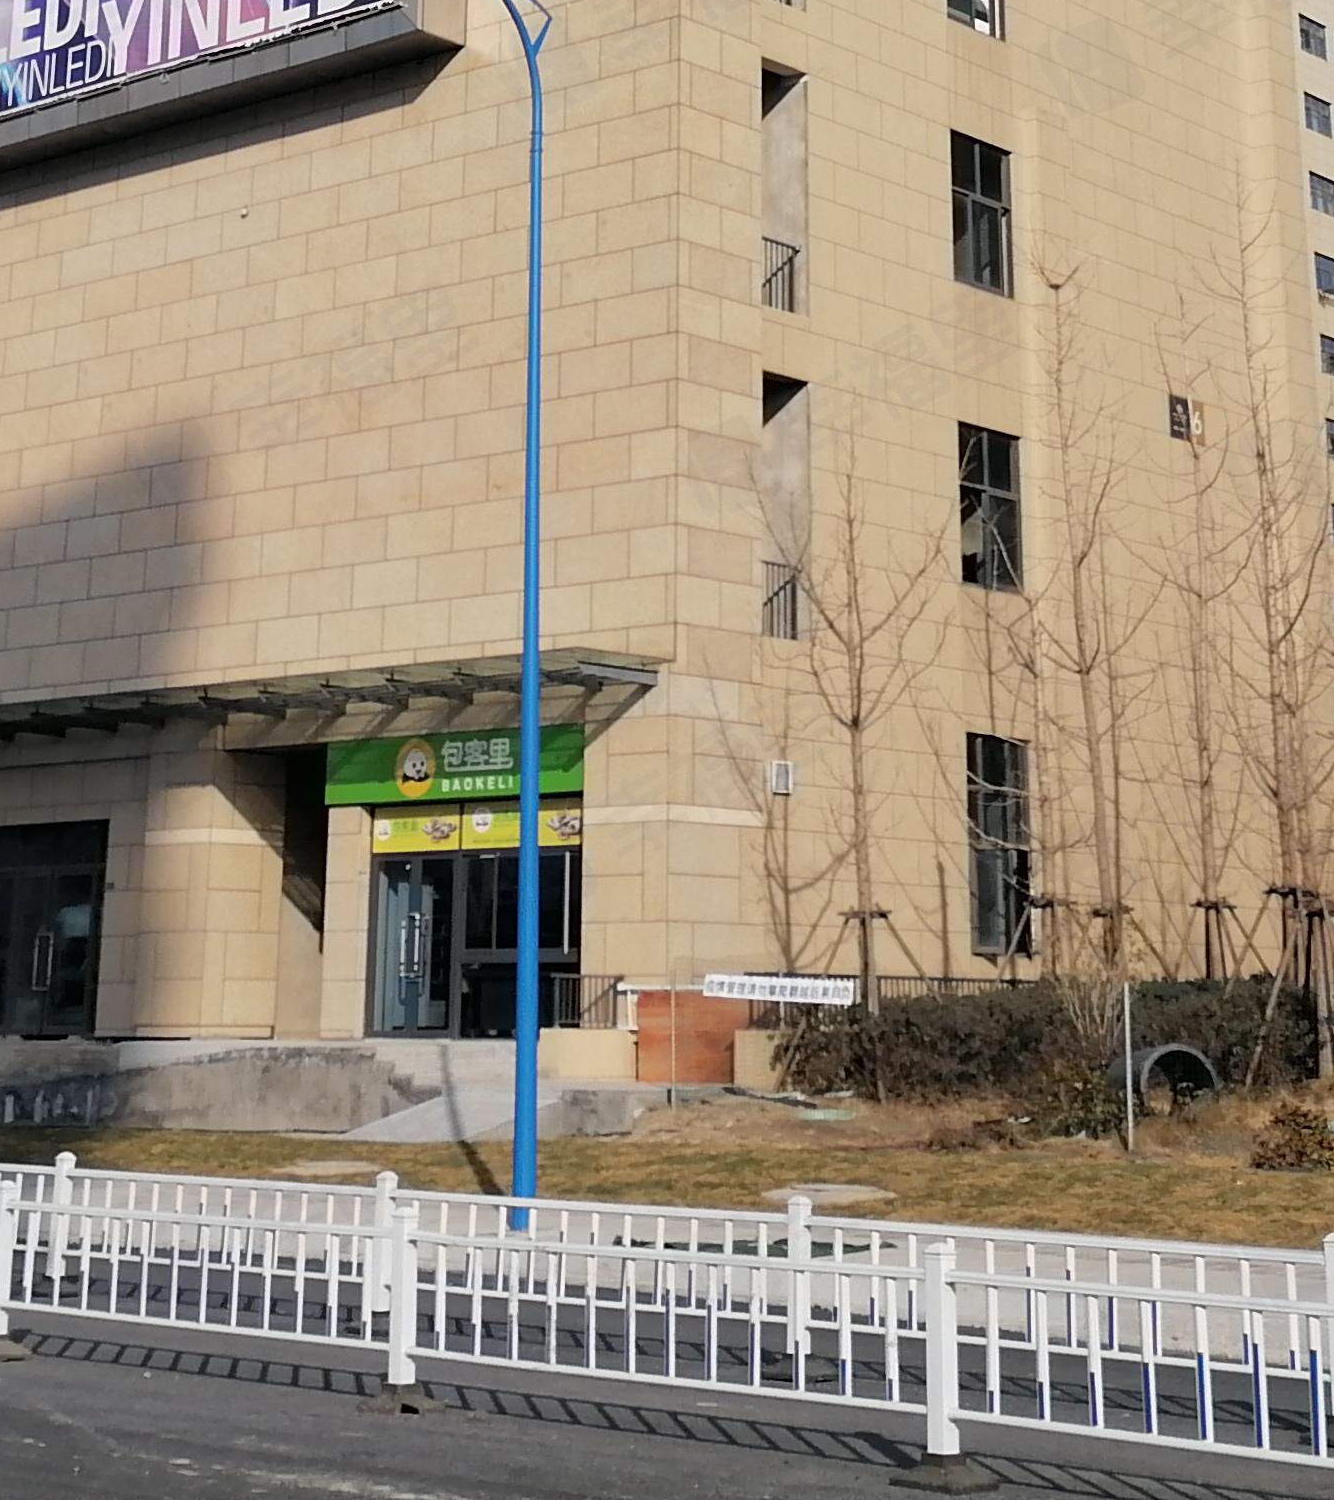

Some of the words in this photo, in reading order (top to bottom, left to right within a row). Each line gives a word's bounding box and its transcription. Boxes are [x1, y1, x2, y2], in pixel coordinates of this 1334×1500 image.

[2, 36, 115, 106] YINLEDI
[1193, 411, 1203, 435] 6
[441, 738, 514, 772] 包客里
[441, 775, 515, 792] BAOKELI
